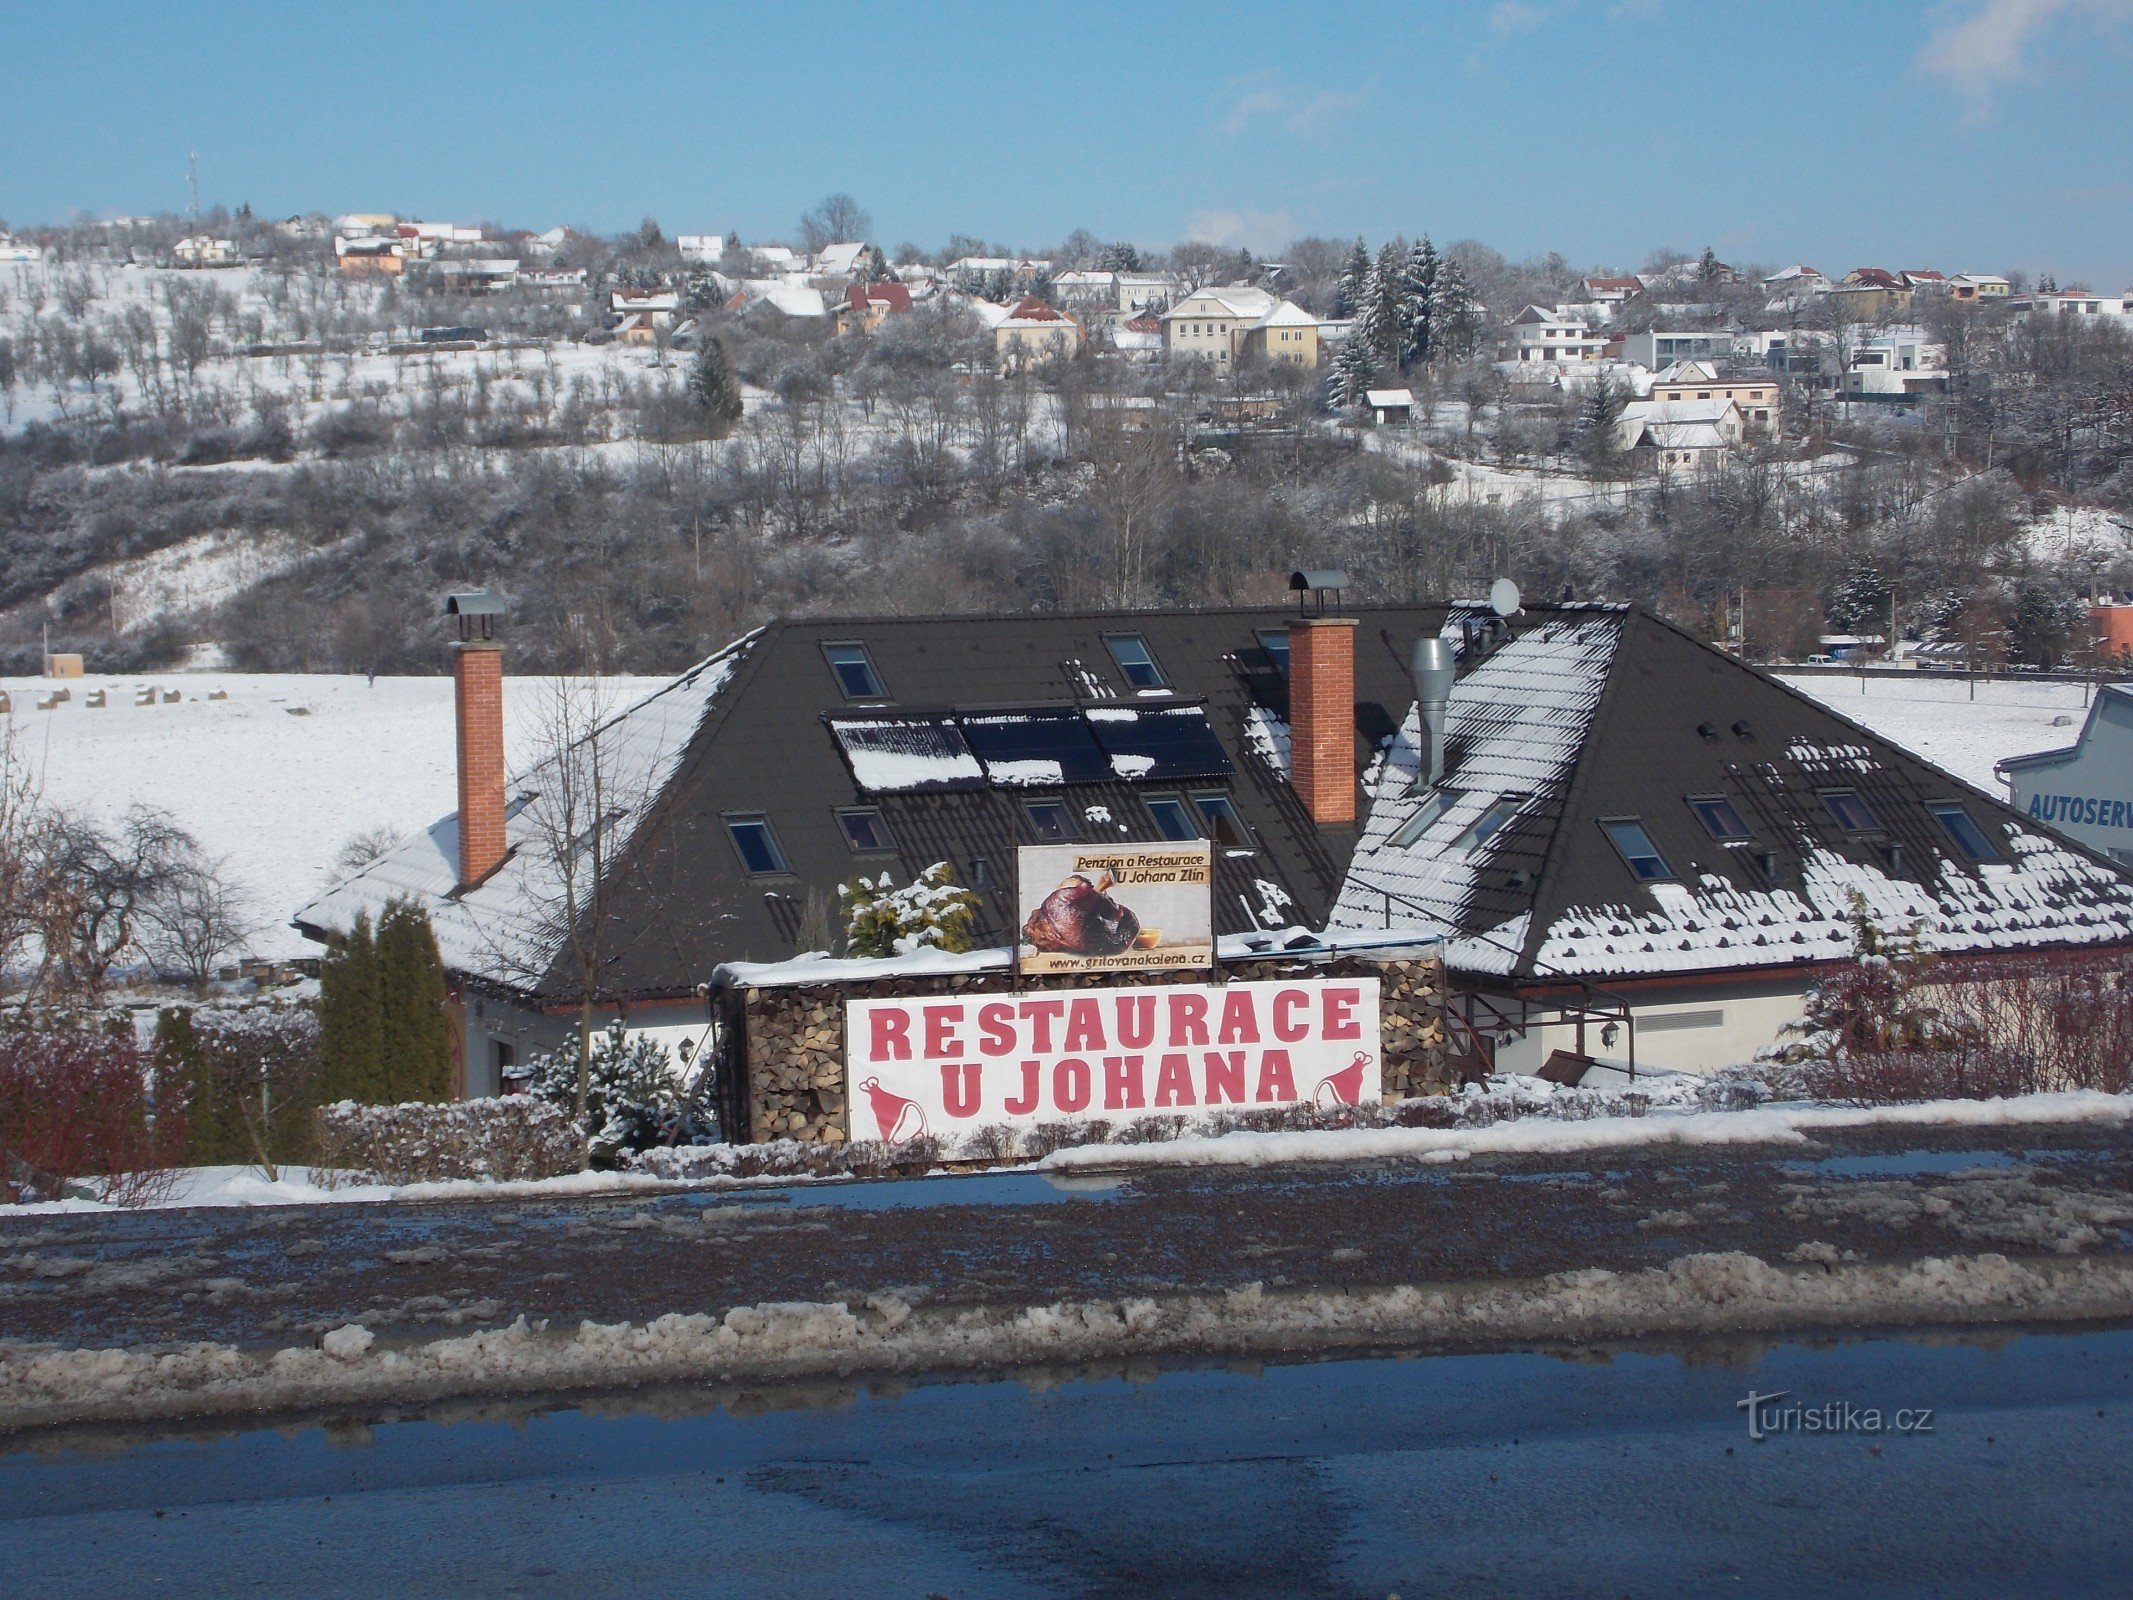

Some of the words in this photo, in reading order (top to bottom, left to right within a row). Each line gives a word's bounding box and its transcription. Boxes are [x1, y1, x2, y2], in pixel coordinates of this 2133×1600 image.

[1077, 856, 1123, 869] Penzion
[1126, 857, 1134, 867] a
[1137, 855, 1204, 867] Restaurace
[1116, 871, 1126, 884] U
[1129, 869, 1176, 883] Johana
[1180, 867, 1204, 882] Zlín
[1049, 954, 1205, 969] www.grilovanakolena.cz
[868, 988, 1361, 1061] RESTAURACE
[940, 1063, 983, 1118] U
[1003, 1049, 1297, 1116] JOHANA
